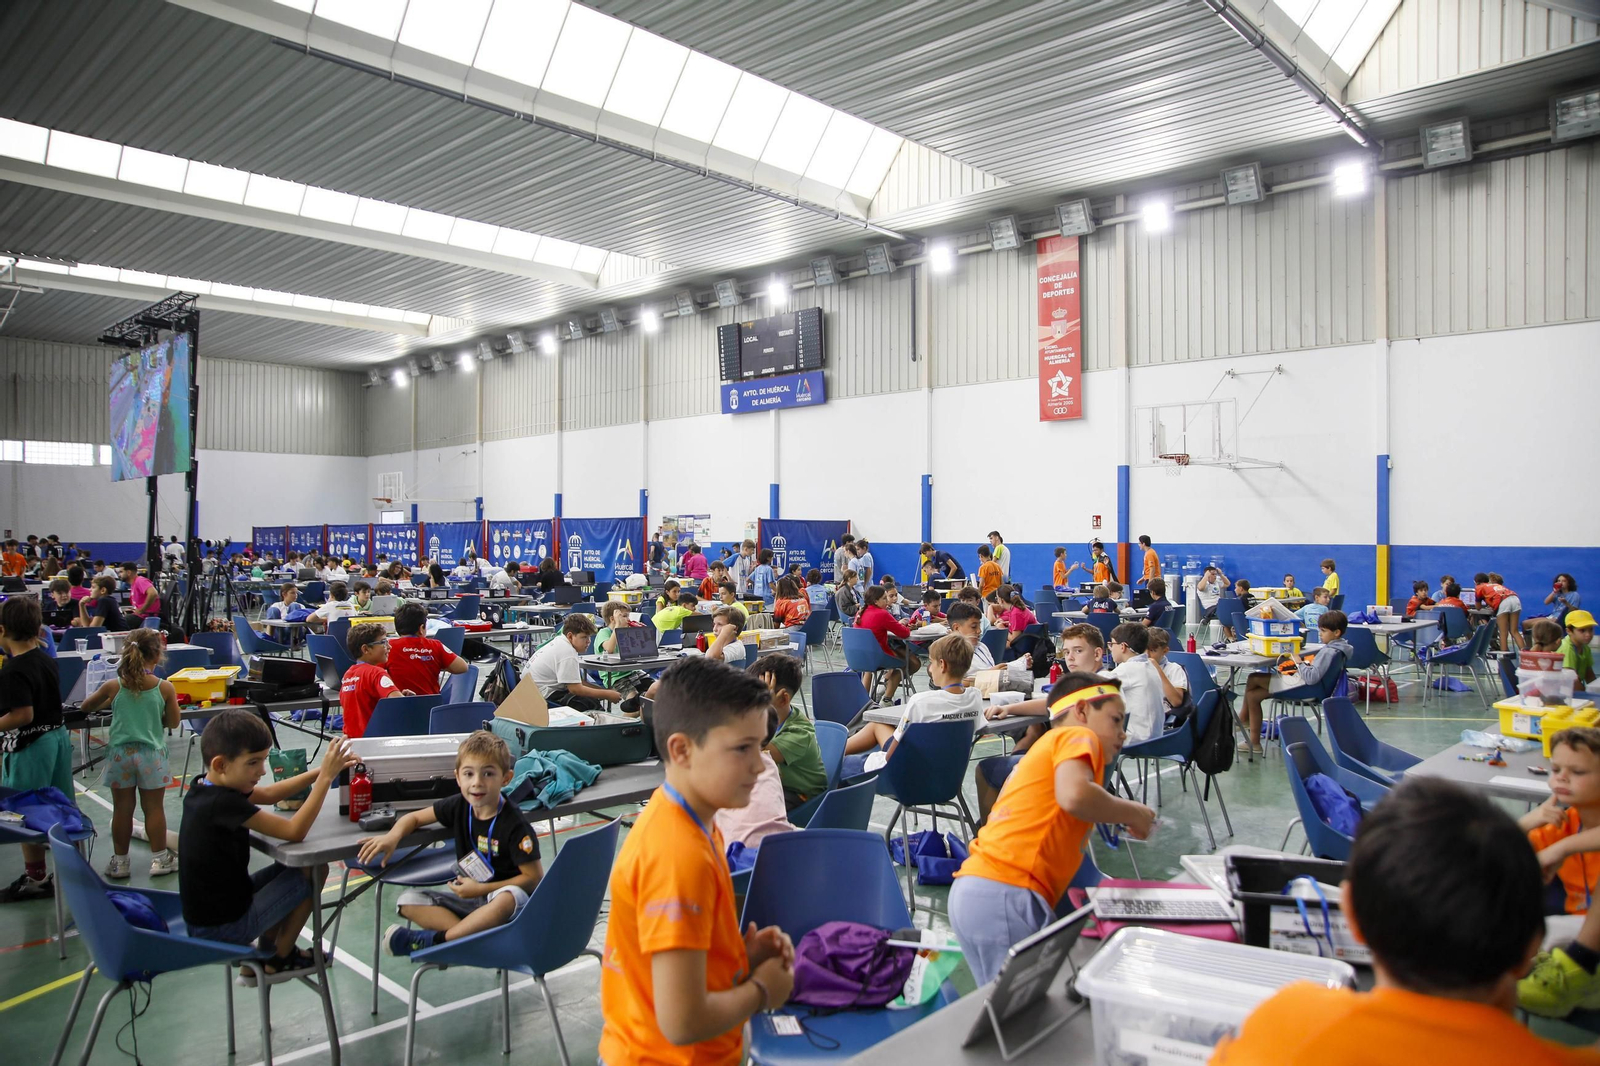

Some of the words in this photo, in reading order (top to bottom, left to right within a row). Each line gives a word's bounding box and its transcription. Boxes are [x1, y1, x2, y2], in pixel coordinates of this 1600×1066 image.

[1039, 271, 1078, 284] CONCEJALÍA
[1042, 288, 1075, 299] DEPORTES
[766, 385, 790, 395] HUÉRCAL
[760, 396, 781, 405] ALMERÍA
[614, 562, 634, 571] Huércal
